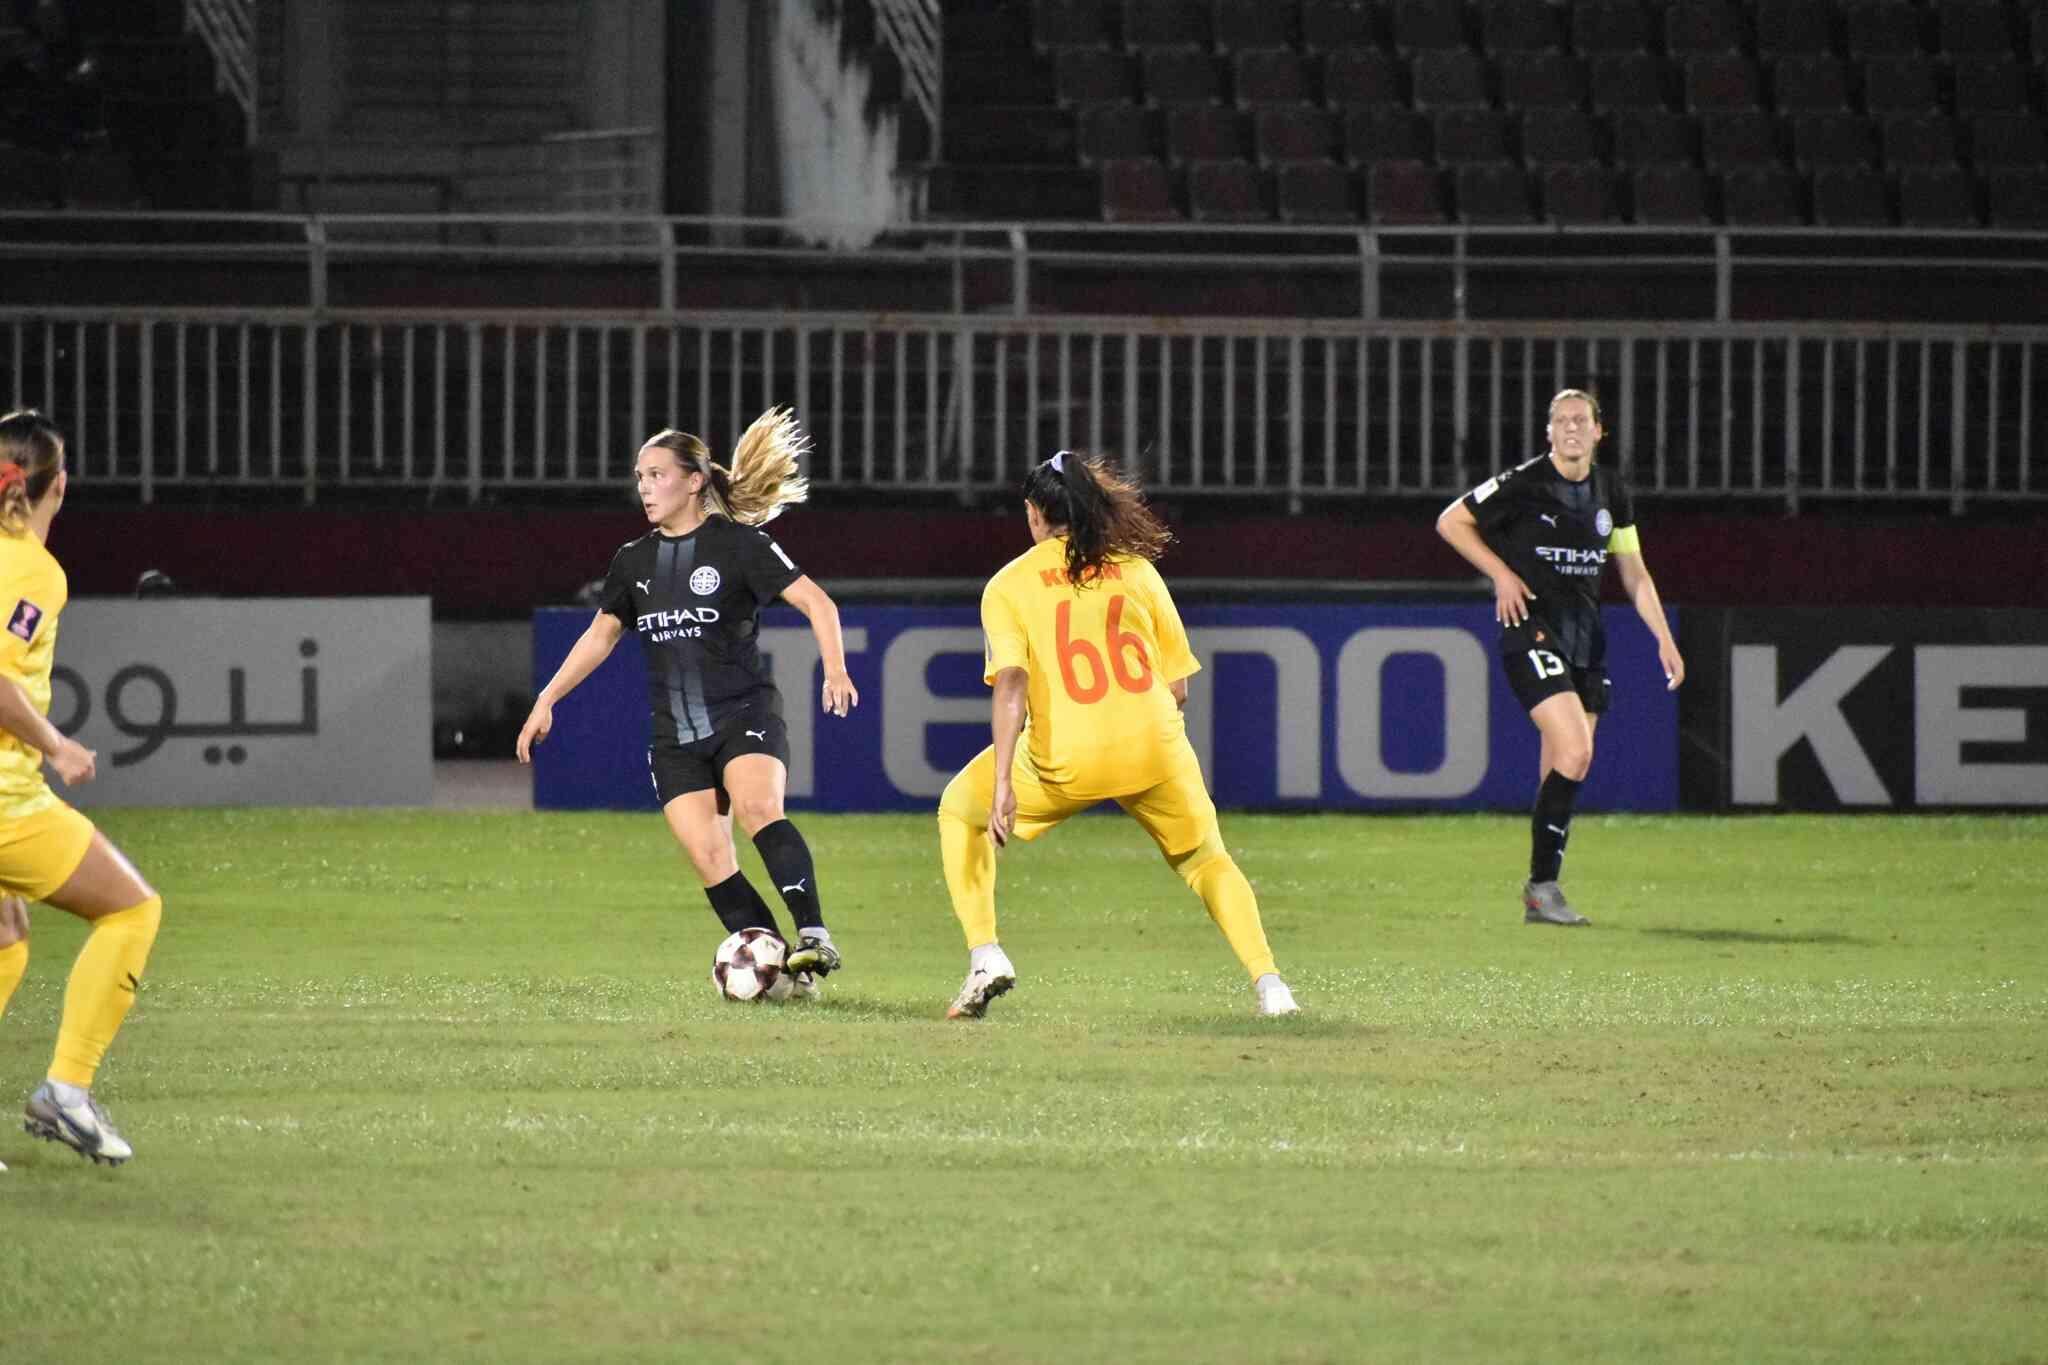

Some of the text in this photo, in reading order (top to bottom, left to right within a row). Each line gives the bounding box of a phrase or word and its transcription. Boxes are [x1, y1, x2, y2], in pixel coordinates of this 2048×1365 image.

[637, 607, 720, 632] ETIHAD
[651, 626, 702, 643] AIRWAYS
[1055, 594, 1153, 705] 66
[1527, 648, 1565, 680] 13
[754, 626, 1491, 799] TENO
[1731, 645, 2048, 804] KE
